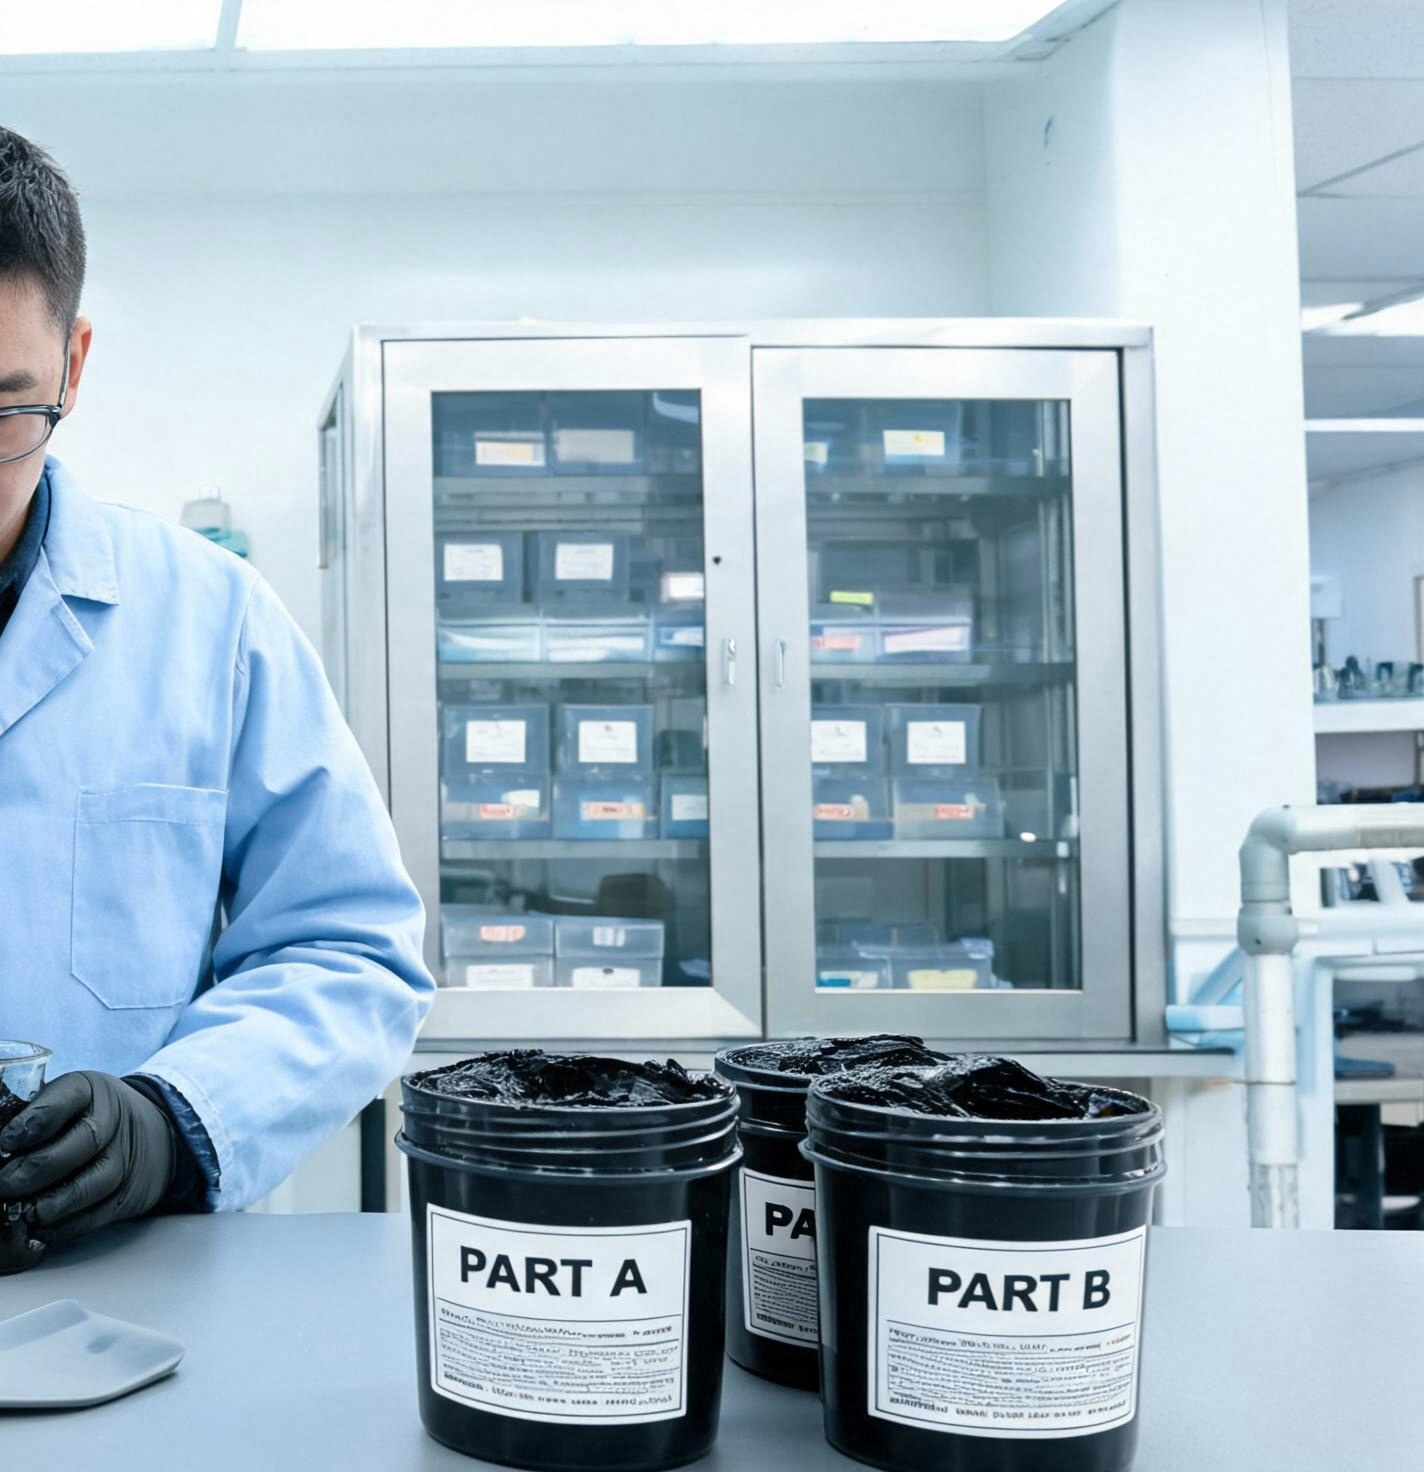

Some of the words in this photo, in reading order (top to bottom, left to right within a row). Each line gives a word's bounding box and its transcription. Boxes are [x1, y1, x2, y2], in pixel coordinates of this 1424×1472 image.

[460, 1245, 593, 1297] PART
[610, 1259, 647, 1297] A
[928, 1267, 1070, 1312] PART
[1083, 1269, 1110, 1310] B
